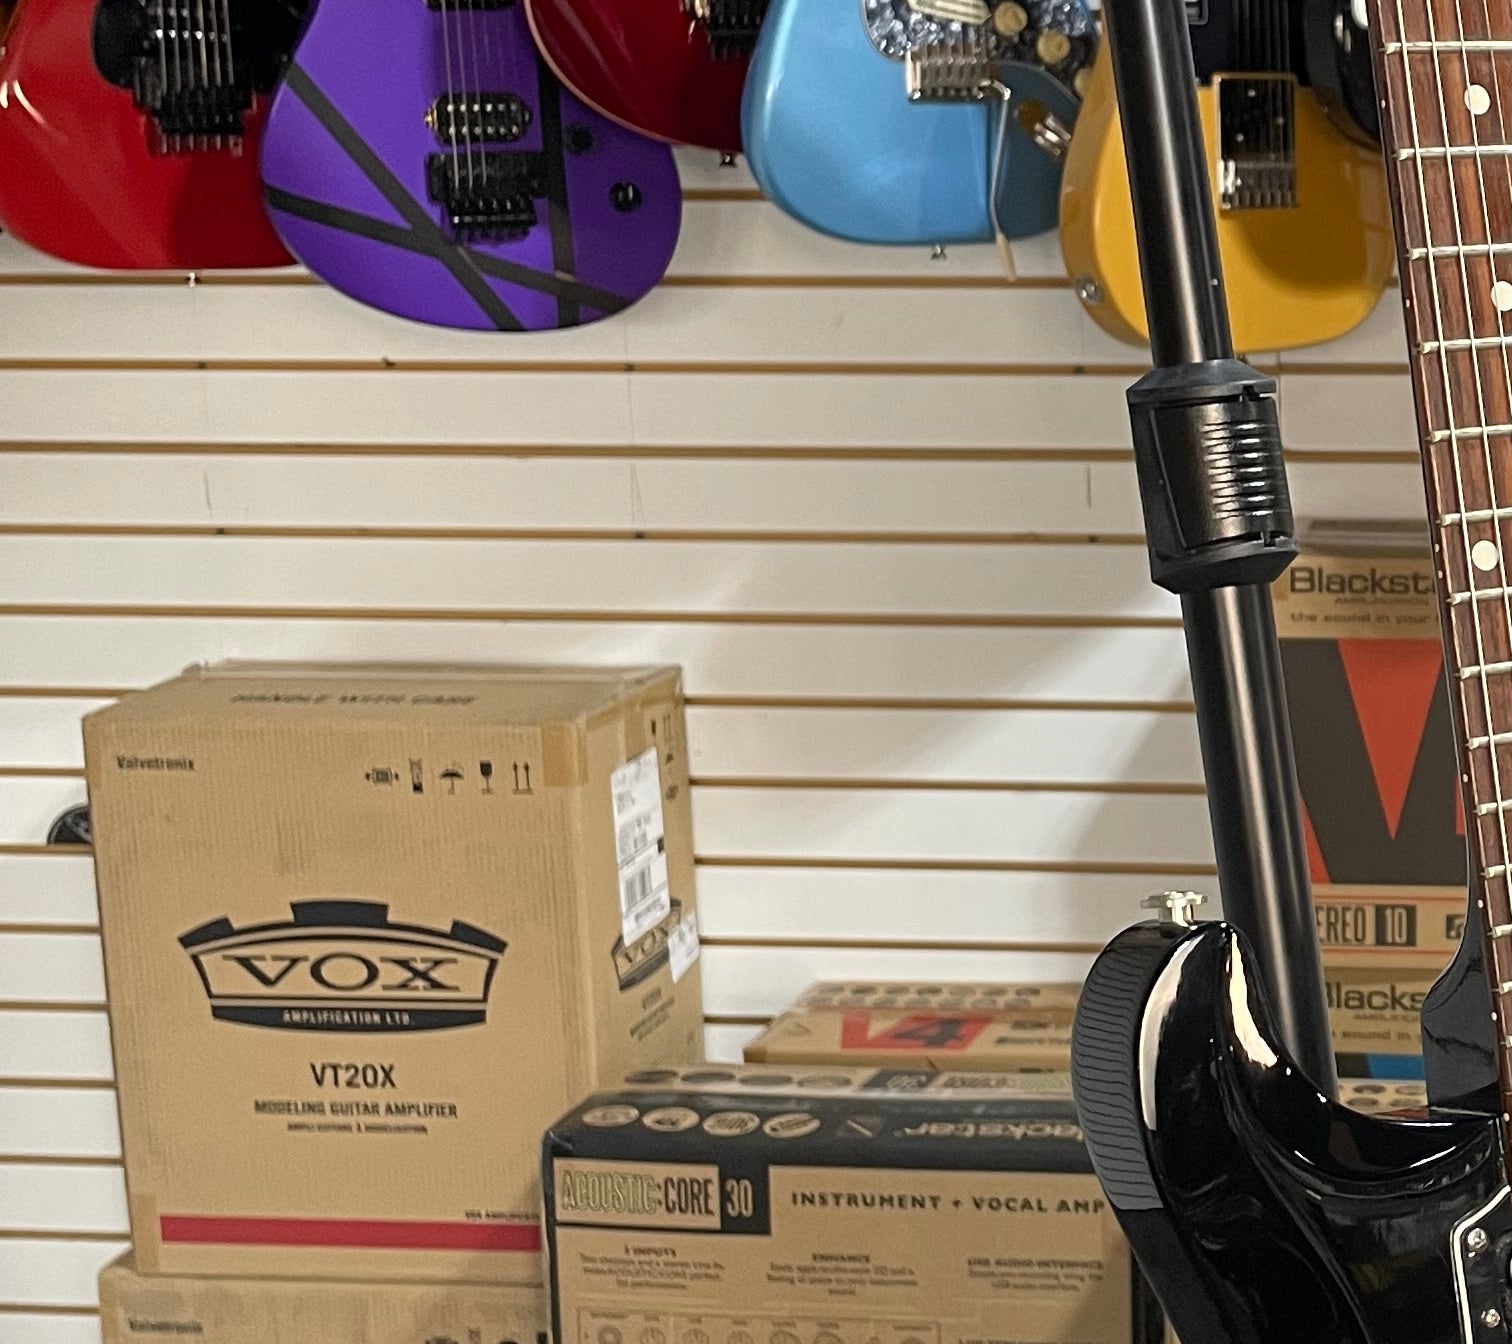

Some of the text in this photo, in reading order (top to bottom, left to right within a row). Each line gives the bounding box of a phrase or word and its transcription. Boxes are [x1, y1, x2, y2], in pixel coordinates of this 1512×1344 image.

[1290, 565, 1436, 594] Blackst
[1383, 907, 1408, 944] 10
[221, 951, 462, 993] VOX
[281, 1008, 382, 1026] AMPLIFICATION
[309, 1061, 398, 1090] VT20X
[253, 1099, 458, 1120] MODELING GUITAR AMPLIFIER
[725, 1178, 754, 1219] 30
[790, 1191, 943, 1211] INSTRUMENT
[970, 1196, 1049, 1214] VOCAL
